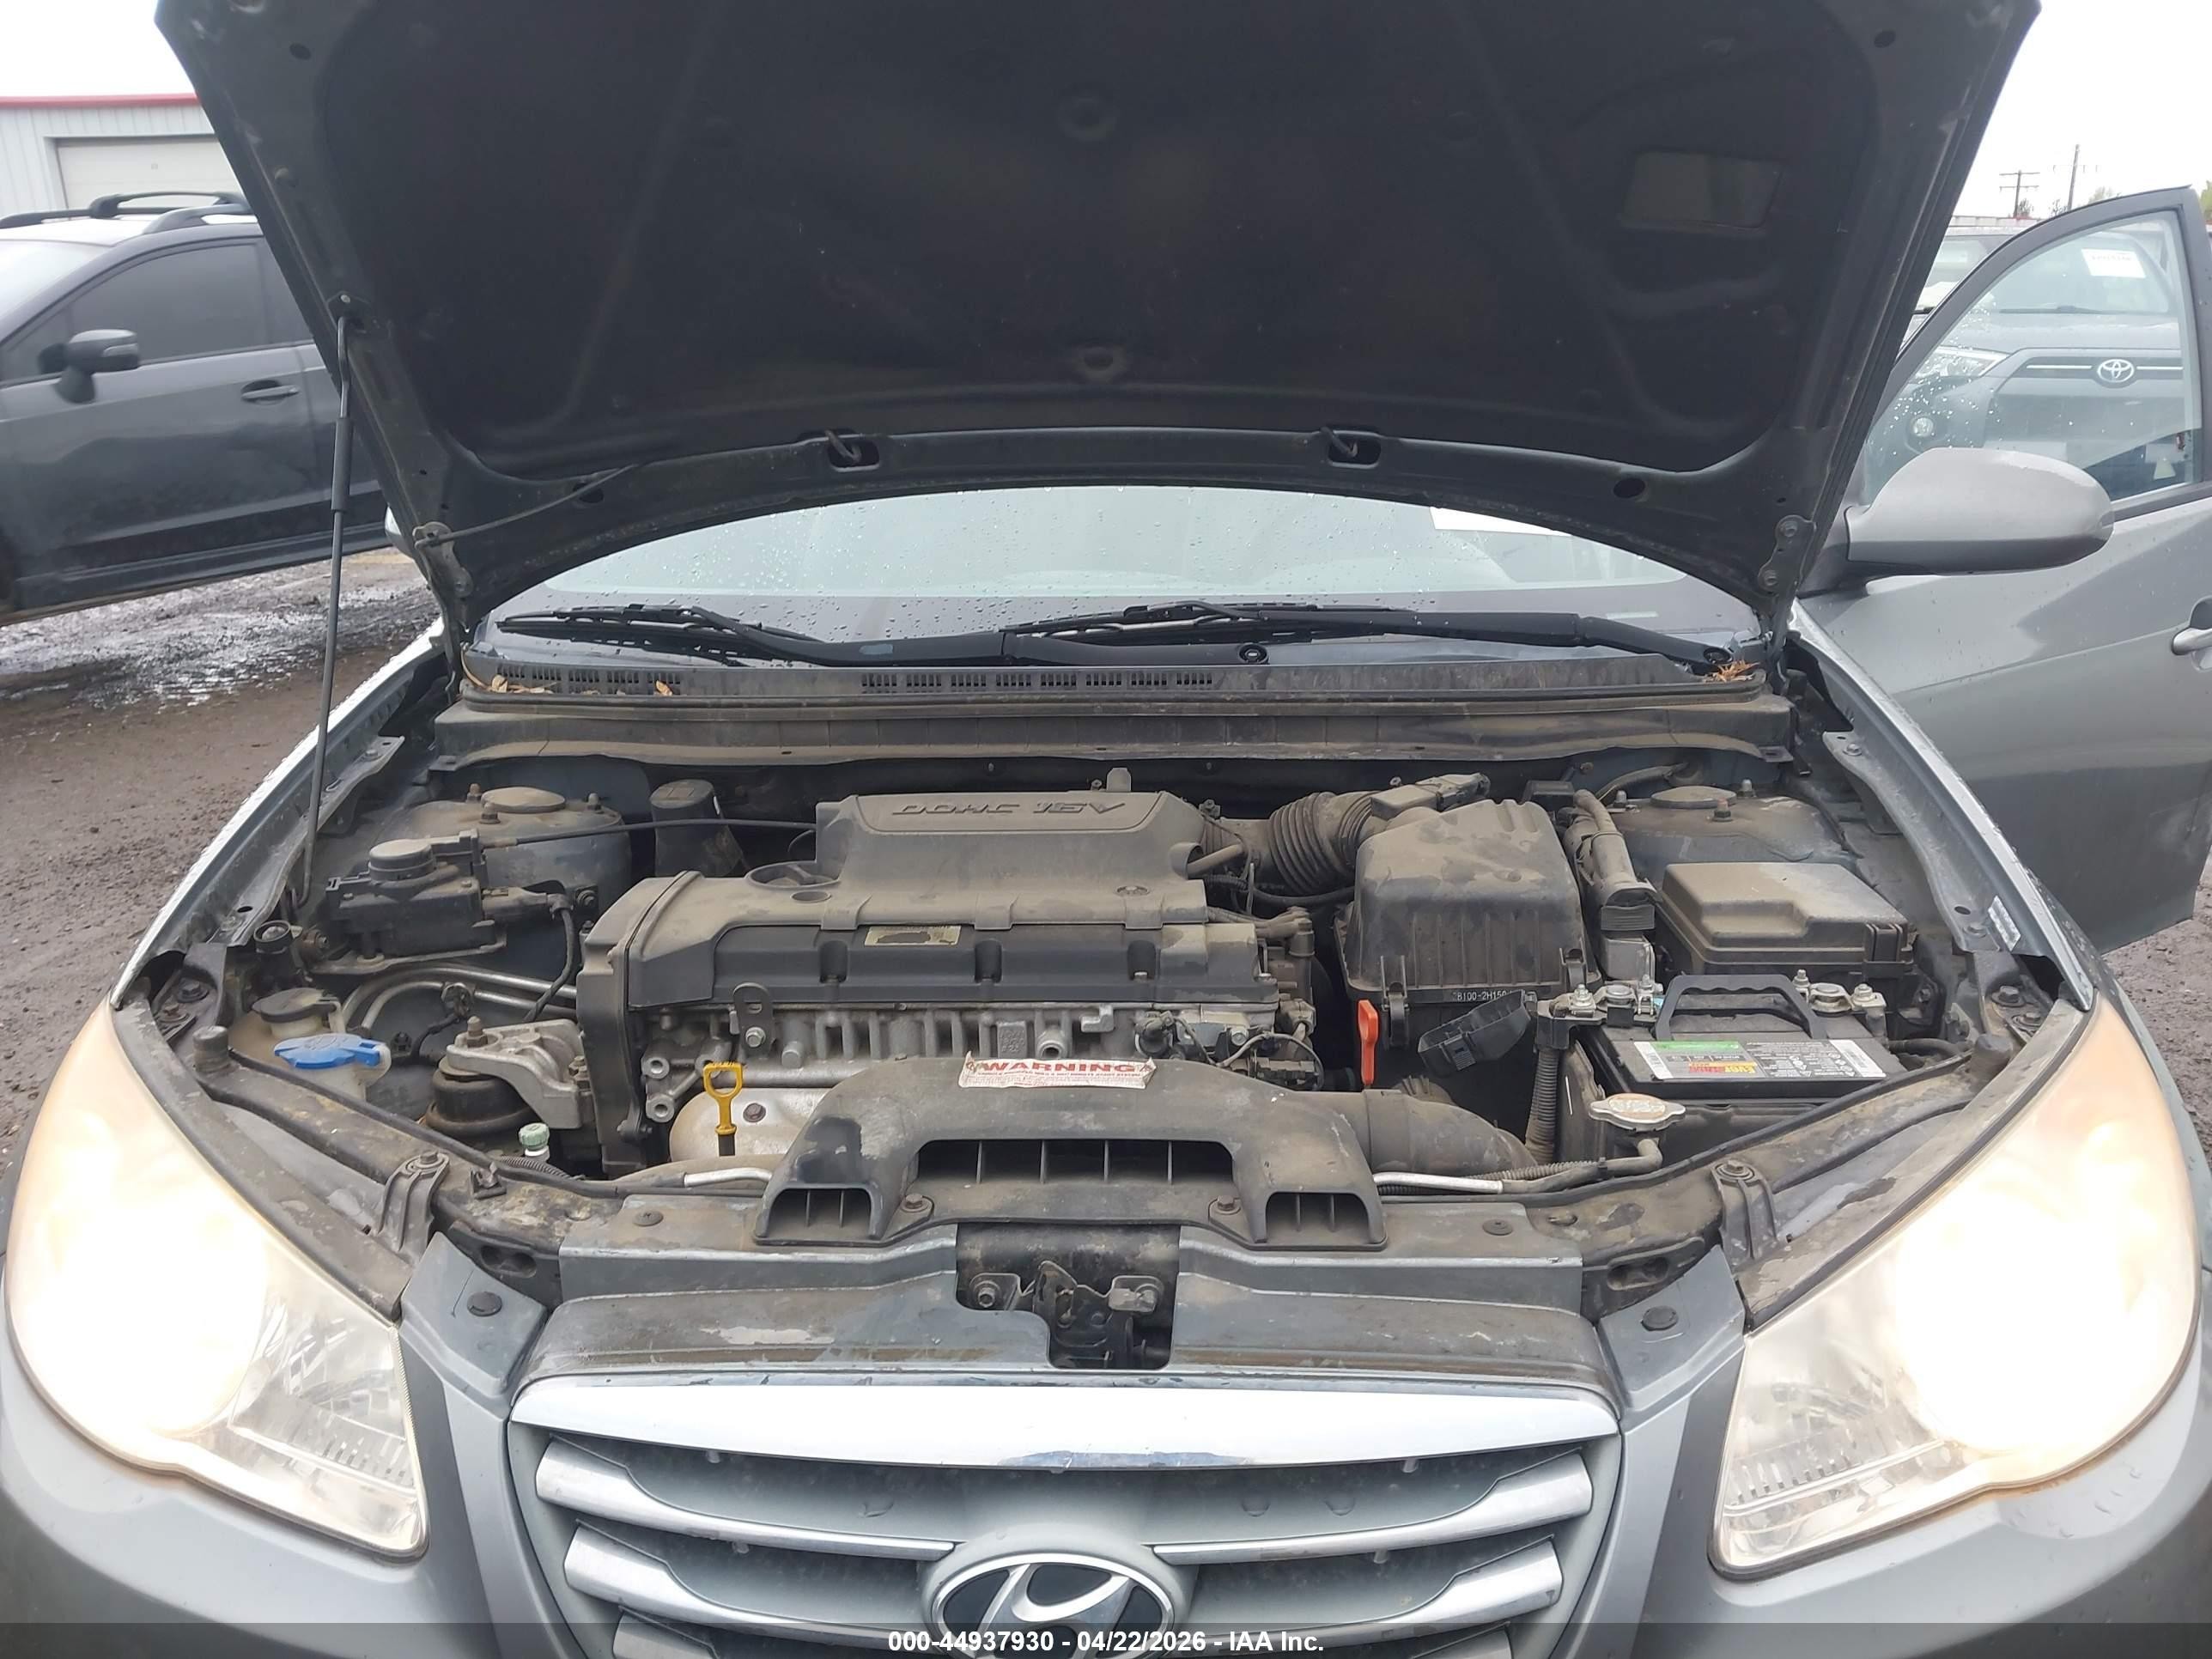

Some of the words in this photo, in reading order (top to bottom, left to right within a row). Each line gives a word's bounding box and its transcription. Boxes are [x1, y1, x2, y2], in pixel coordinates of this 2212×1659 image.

[892, 802, 1020, 816] DOHC
[1033, 802, 1126, 815] 16V
[978, 1061, 1136, 1073] WARNING
